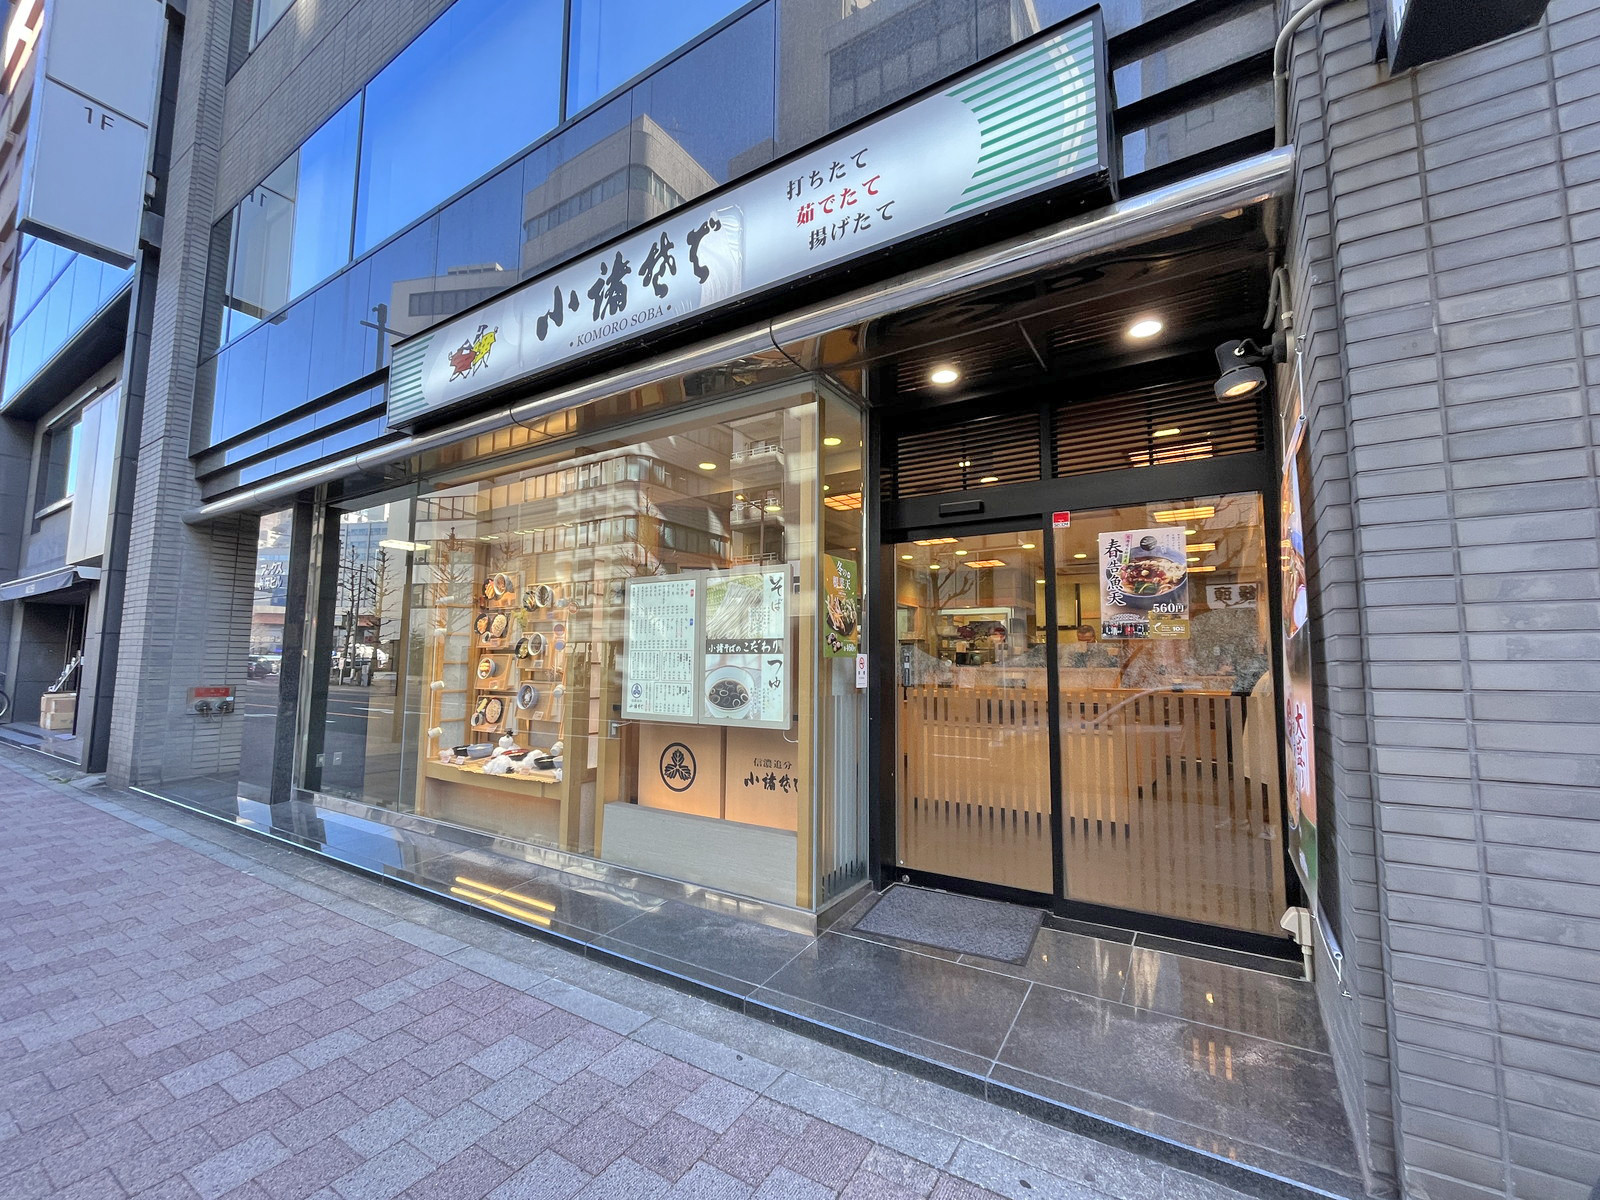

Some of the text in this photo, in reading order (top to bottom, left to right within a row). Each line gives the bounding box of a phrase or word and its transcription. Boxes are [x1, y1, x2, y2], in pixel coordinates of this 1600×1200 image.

[83, 106, 115, 131] 1F
[785, 147, 870, 202] 打ちたて
[796, 175, 882, 228] 茹でたて
[807, 199, 896, 251] 揚げたて
[577, 305, 665, 348] KOMORO SOBA
[1103, 538, 1127, 607] 春告魚天
[769, 575, 784, 612] そば
[1152, 602, 1185, 614] 560円
[707, 639, 780, 654] 小諸そばのこだわり
[767, 659, 783, 690] つゆ
[753, 757, 793, 770] 信濃追分
